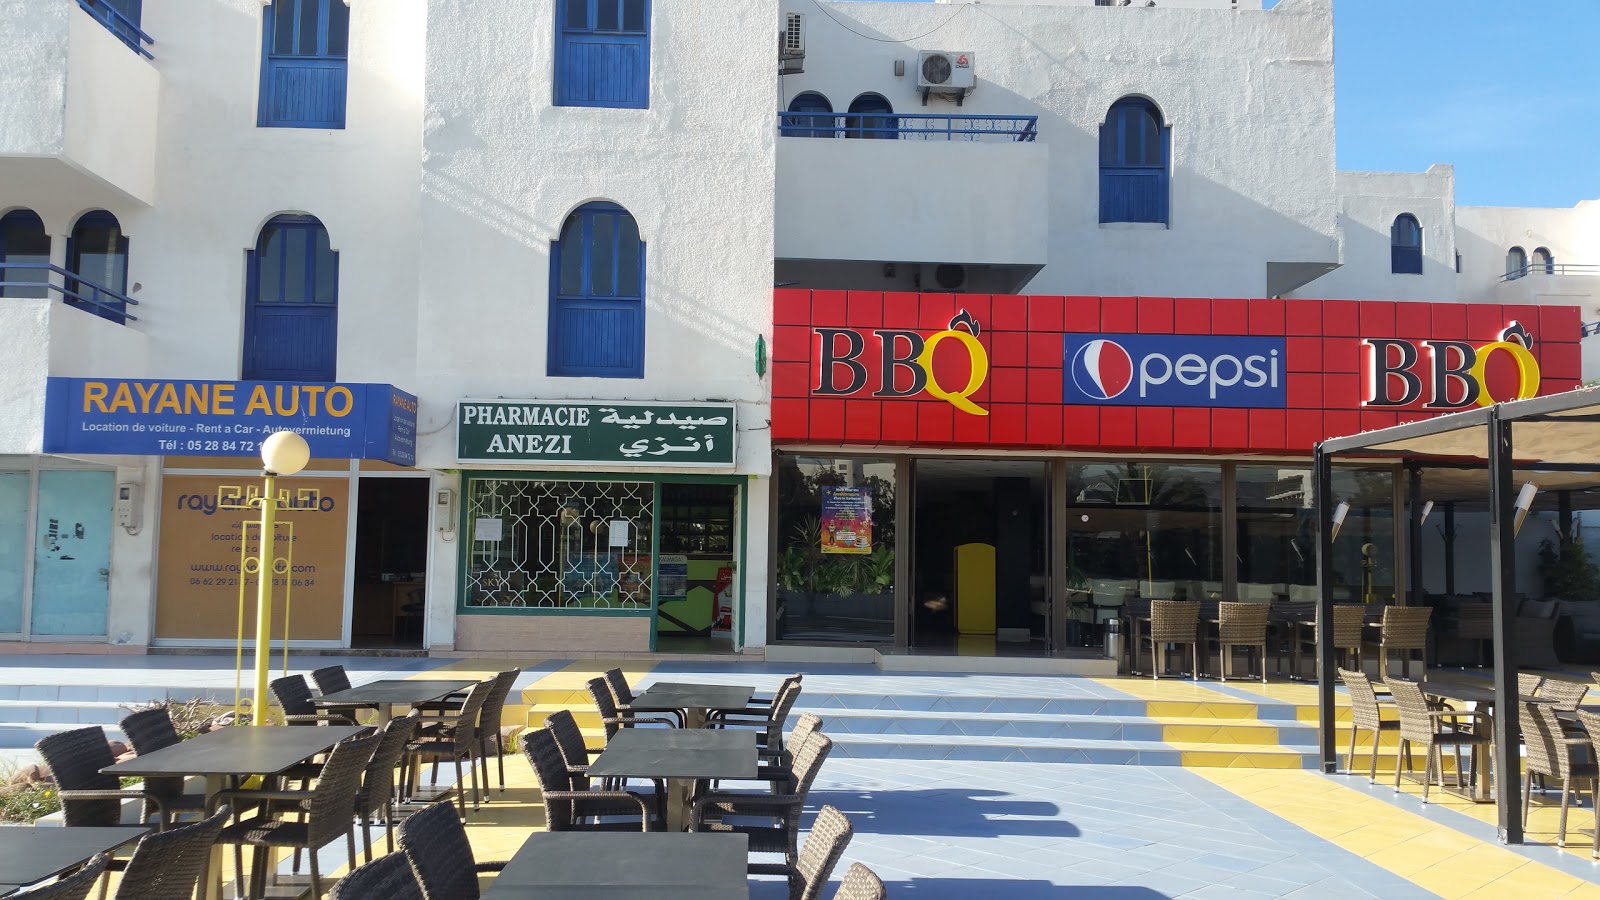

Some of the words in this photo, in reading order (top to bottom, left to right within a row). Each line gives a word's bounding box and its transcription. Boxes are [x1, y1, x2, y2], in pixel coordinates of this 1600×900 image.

[811, 326, 990, 416] BBQ
[1139, 348, 1279, 399] pepsi
[83, 381, 235, 415] RAYANE
[244, 384, 354, 418] AUTO
[463, 406, 590, 427] PHARMACIE
[598, 407, 728, 430] صيدلية
[82, 422, 129, 433] Location
[132, 422, 146, 433] de
[147, 423, 187, 434] voiture
[196, 424, 222, 434] Rent
[224, 426, 231, 434] a
[234, 424, 254, 435] Car
[159, 439, 177, 451] Tél
[187, 441, 202, 451] 05
[204, 441, 219, 451] 28
[222, 441, 237, 451] 84
[240, 441, 254, 452] 72
[486, 434, 572, 454] ANEZI
[619, 434, 714, 458] أنزي
[190, 578, 201, 586] 06
[203, 578, 213, 586] 62
[217, 578, 227, 586] 29
[304, 579, 315, 587] 34
